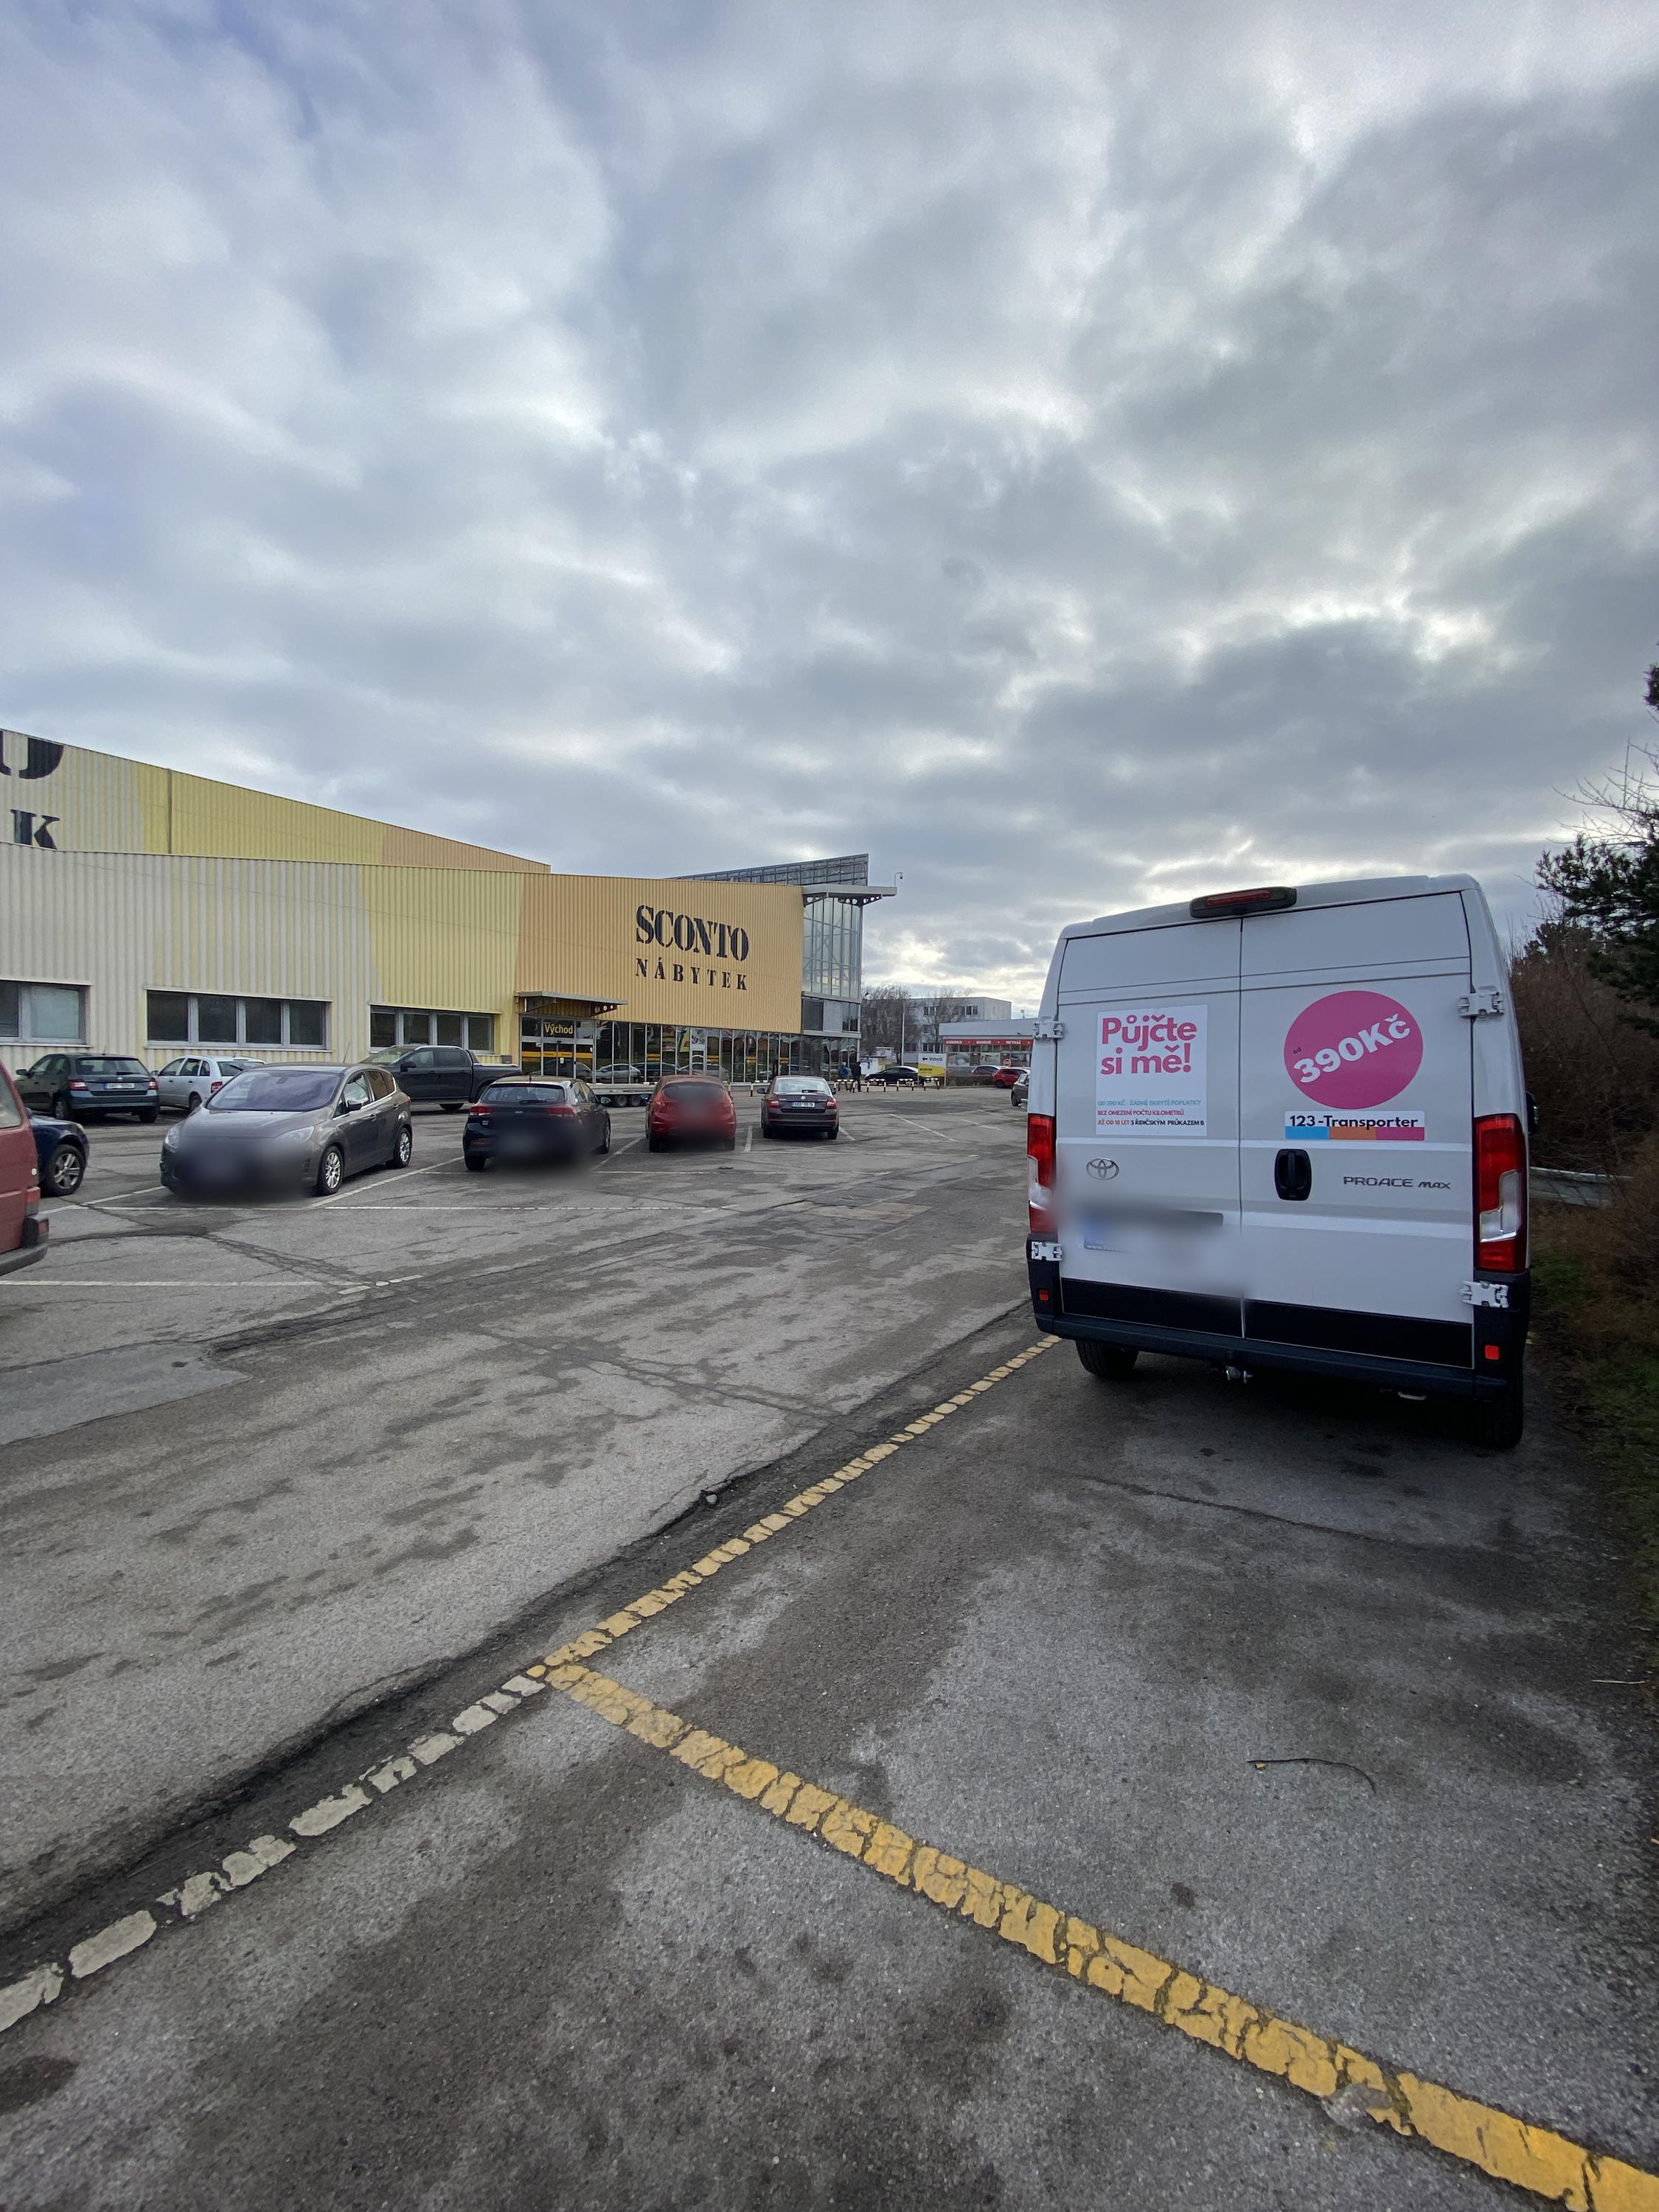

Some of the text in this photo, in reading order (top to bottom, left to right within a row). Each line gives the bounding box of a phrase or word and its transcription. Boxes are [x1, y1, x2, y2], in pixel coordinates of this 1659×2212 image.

[636, 905, 749, 961] SCONTO
[636, 957, 747, 990] NÁBYTEK
[544, 1023, 574, 1035] Východ
[1102, 1015, 1197, 1051] Půjčte
[1100, 1043, 1192, 1075] si mě!
[1293, 1013, 1410, 1083] 390Kč
[1293, 1046, 1302, 1054] od
[1343, 1176, 1414, 1188] PROACE
